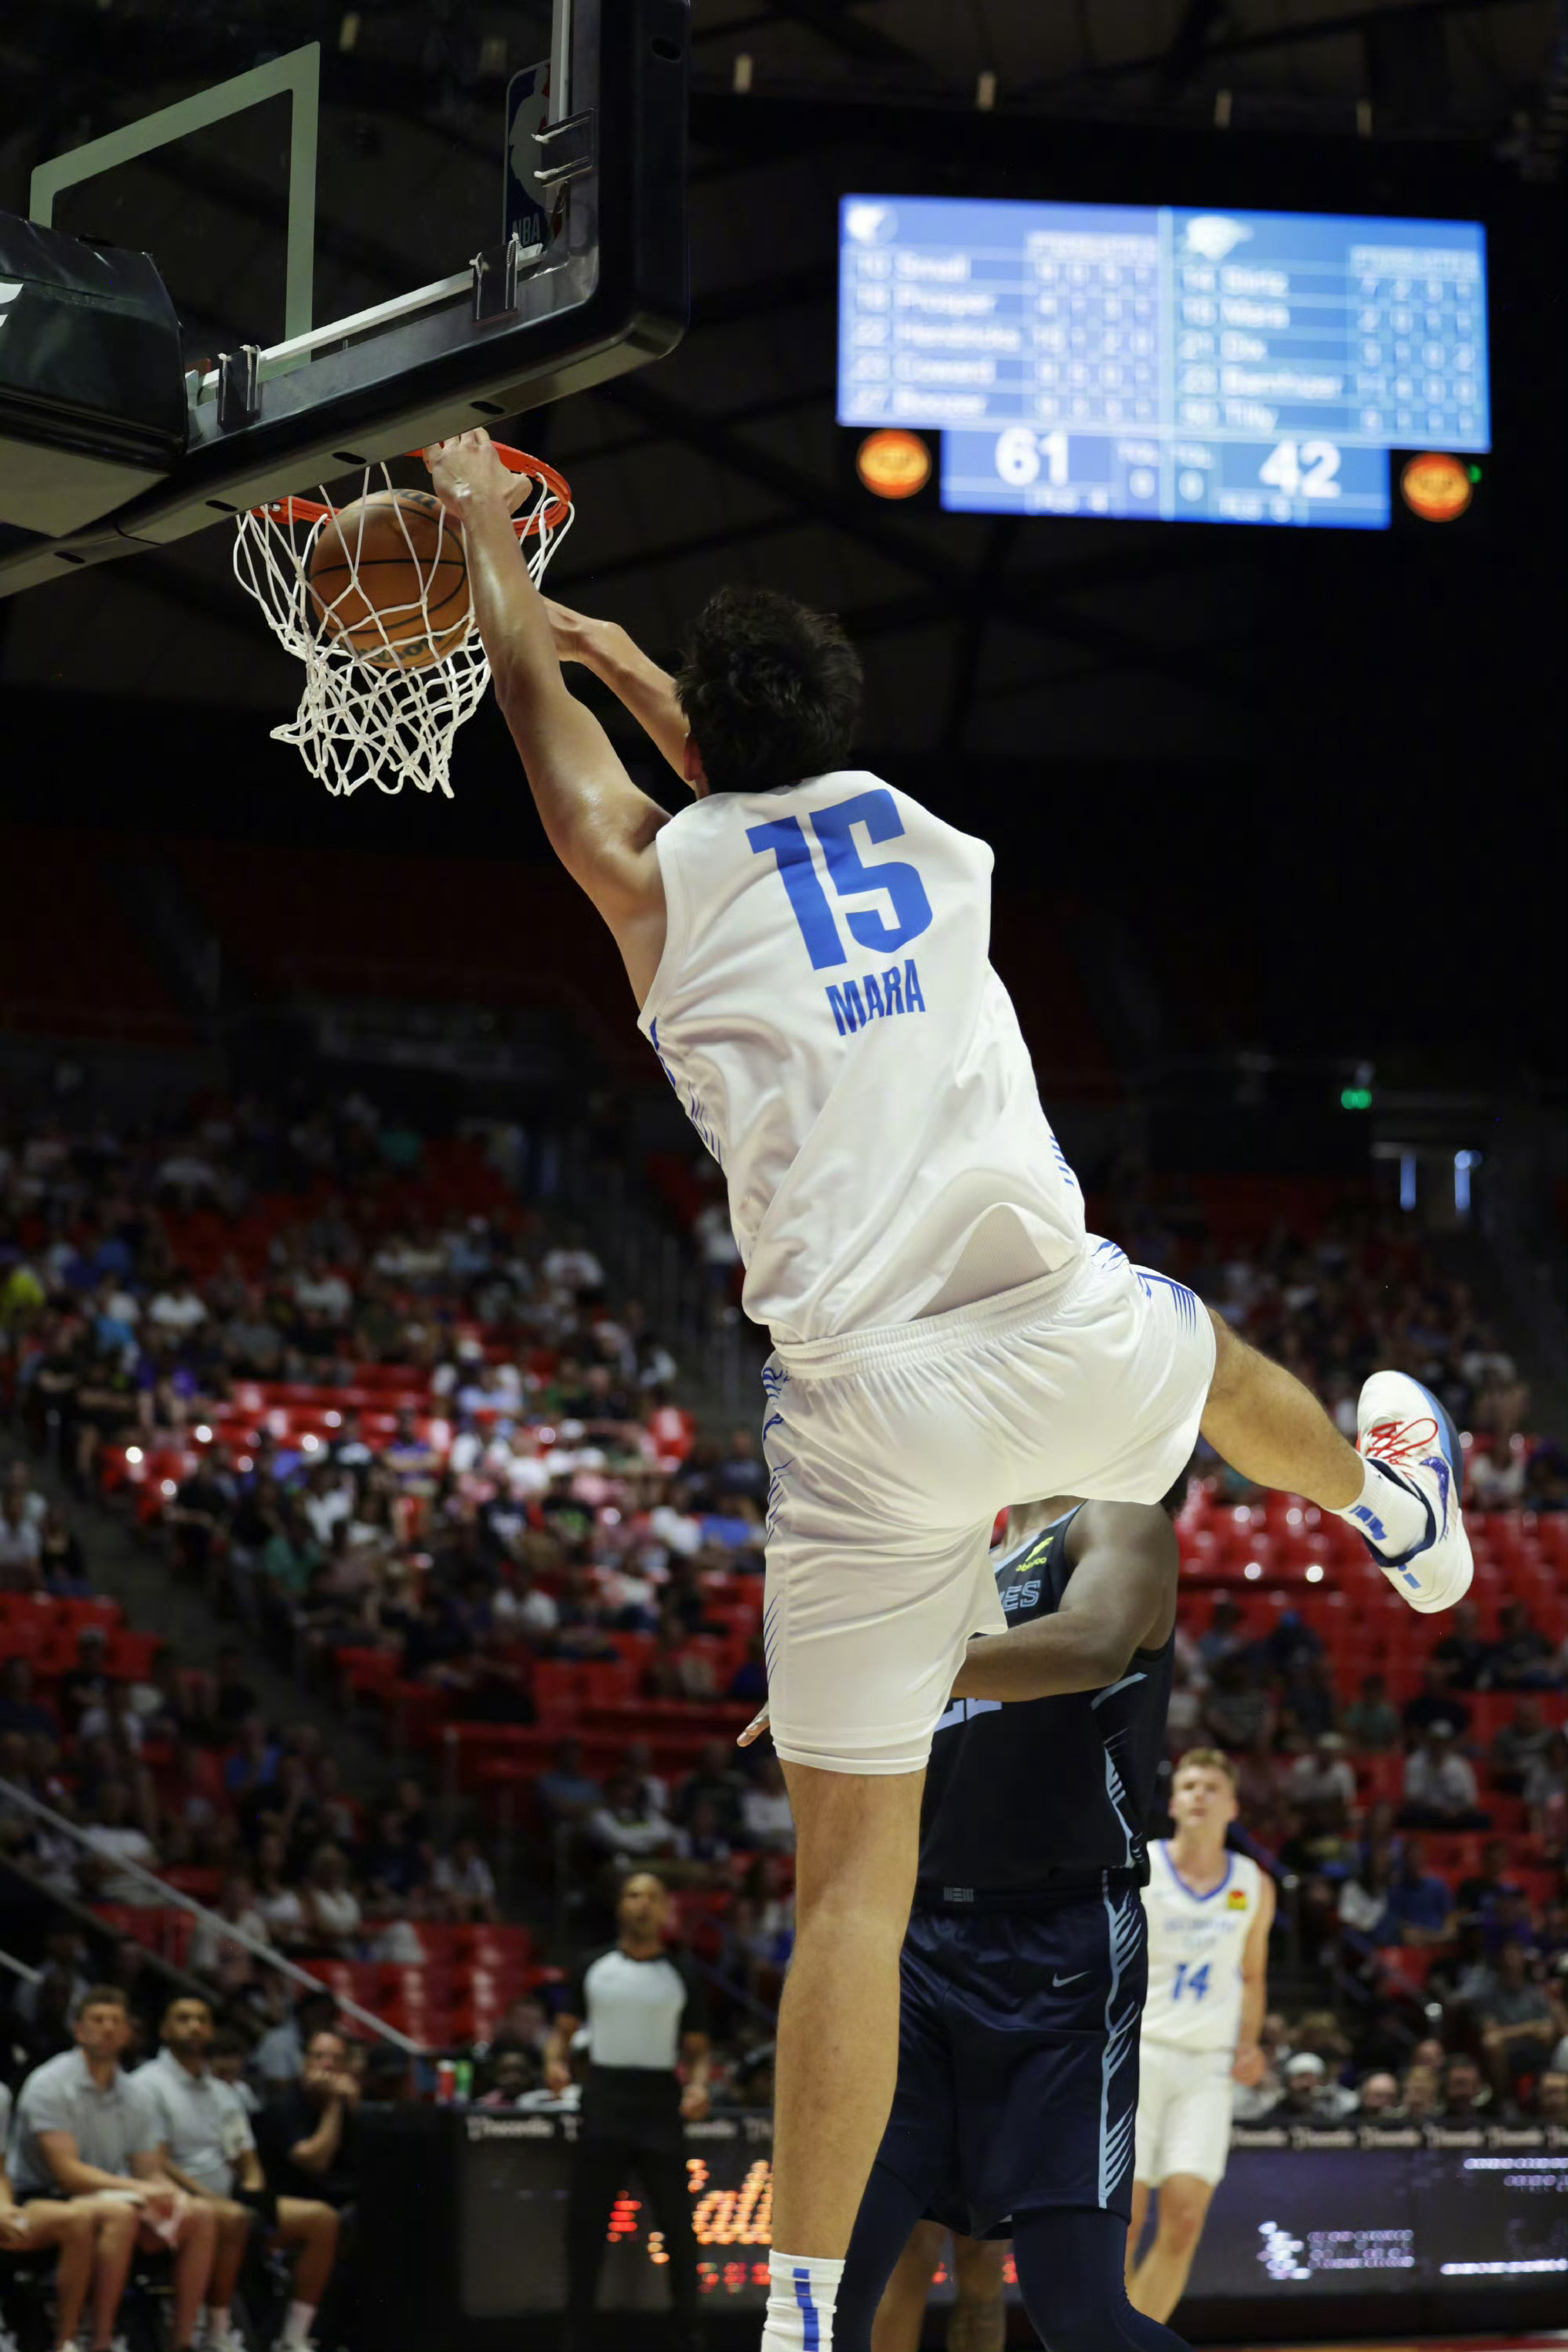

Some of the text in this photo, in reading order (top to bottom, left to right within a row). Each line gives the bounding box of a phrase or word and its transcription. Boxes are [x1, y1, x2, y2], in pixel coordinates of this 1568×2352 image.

[512, 212, 541, 246] NBA
[995, 426, 1069, 487] 61
[1259, 439, 1342, 499] 42
[745, 789, 933, 971] 15
[825, 959, 926, 1036] MARA
[1173, 1962, 1210, 2002] 14
